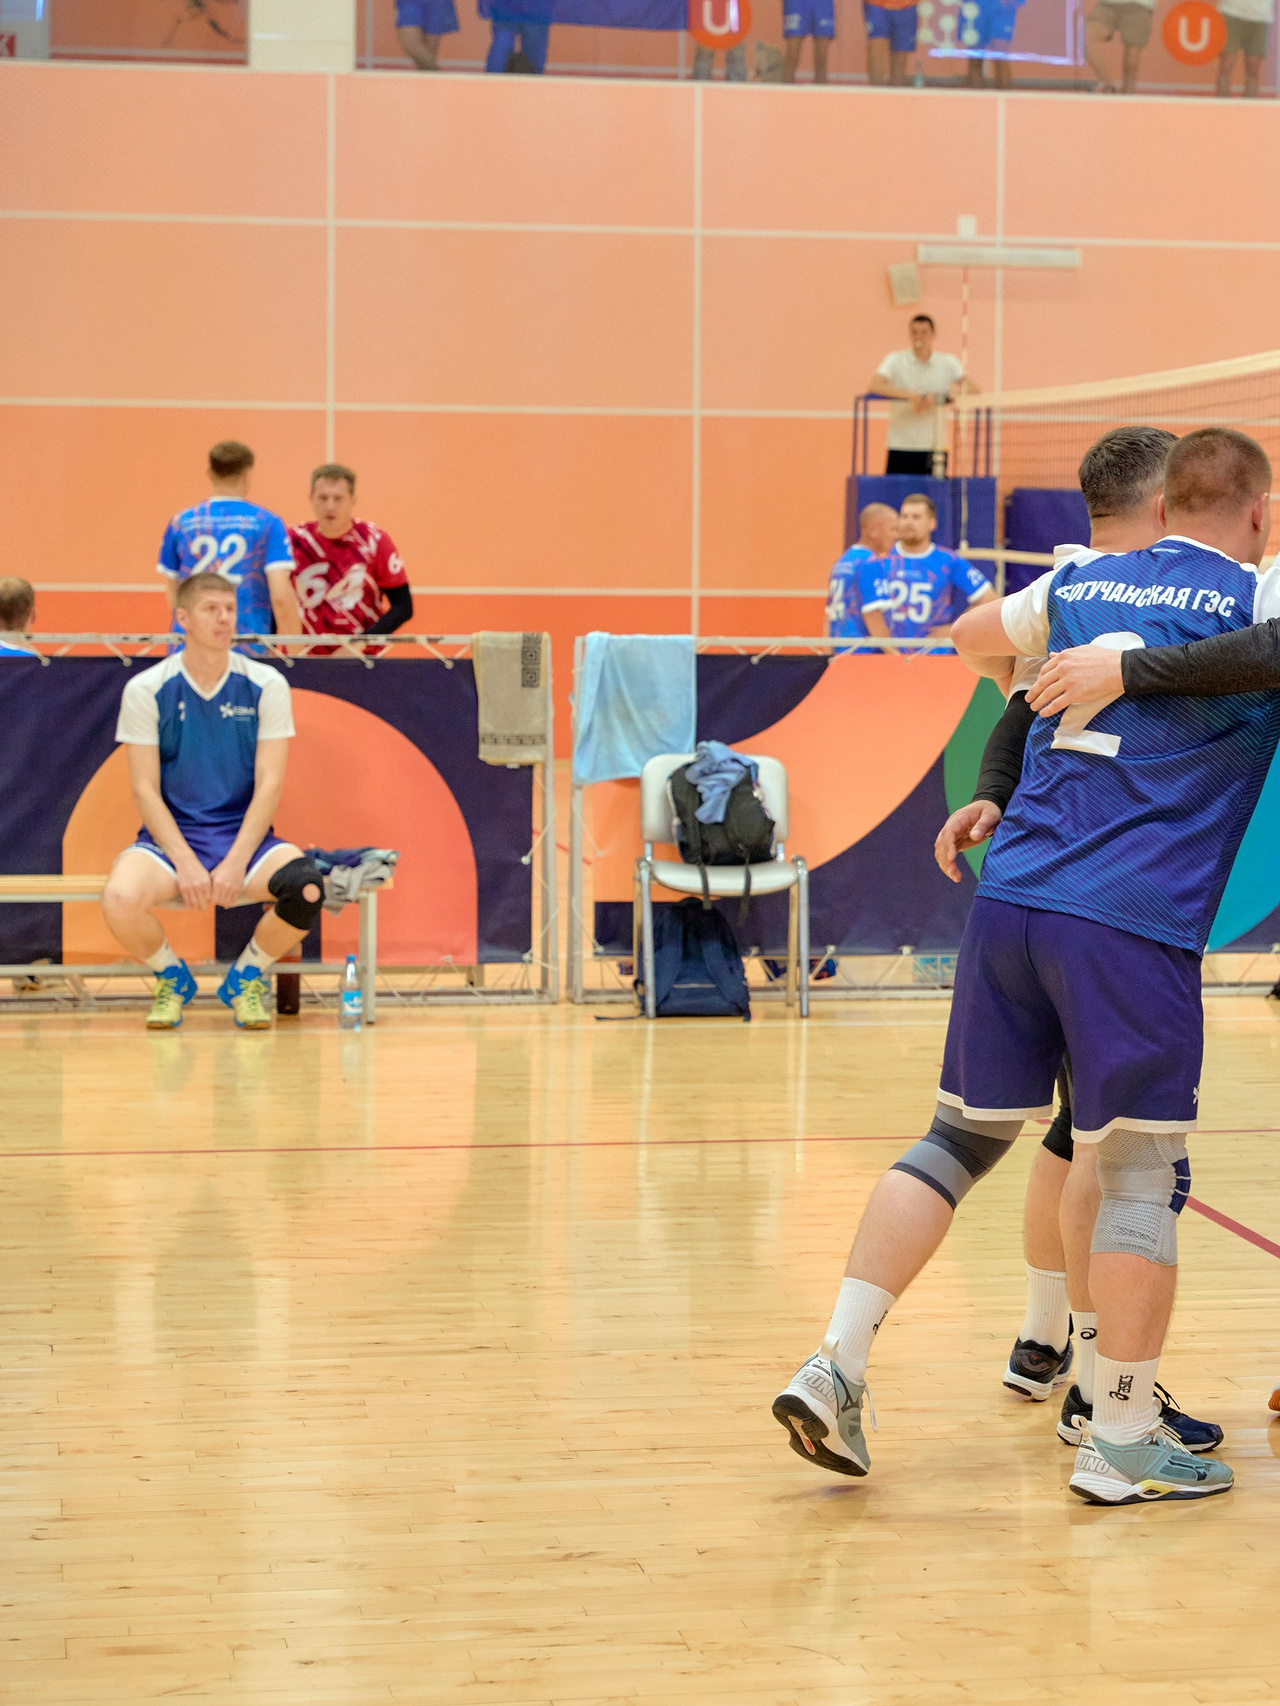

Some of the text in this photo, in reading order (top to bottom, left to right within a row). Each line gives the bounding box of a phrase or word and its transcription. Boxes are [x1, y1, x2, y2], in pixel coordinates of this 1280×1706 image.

[1179, 16, 1209, 53] U
[190, 533, 248, 584] 22
[889, 580, 932, 623] 25
[1055, 580, 1236, 618] БОГУЧАНСКАЯ ГЭС
